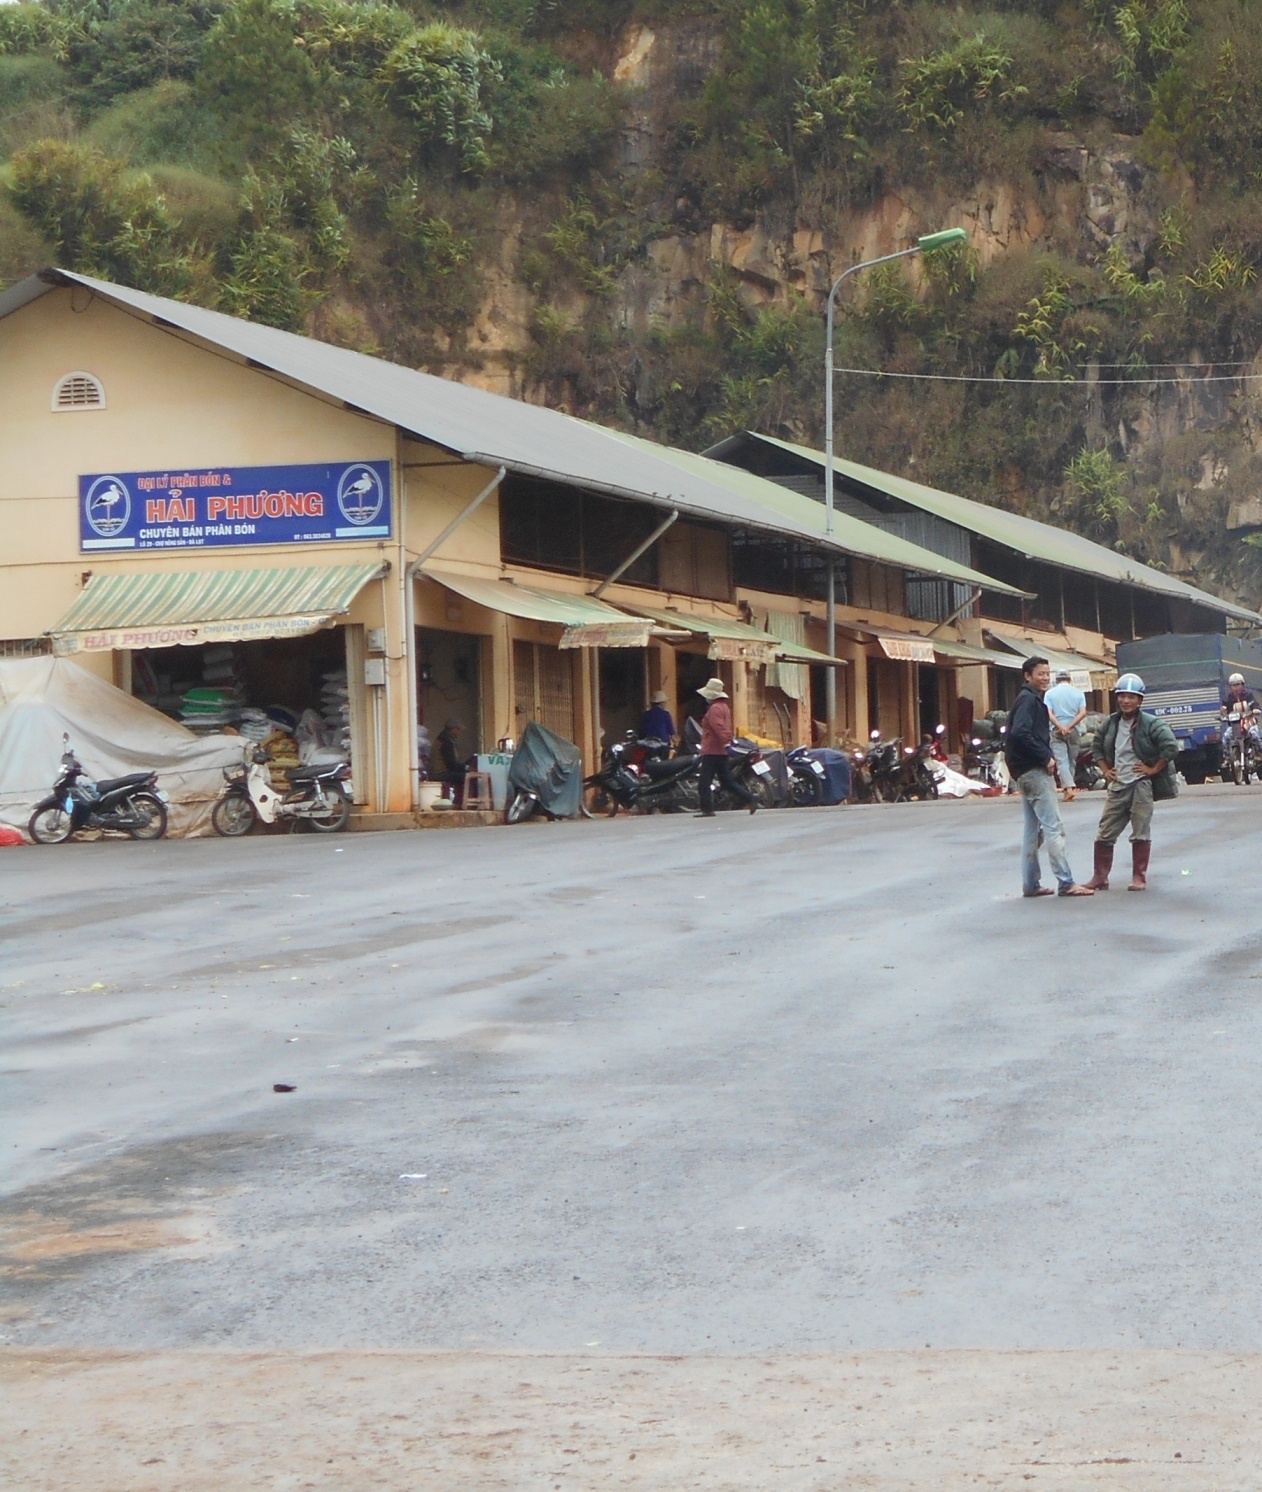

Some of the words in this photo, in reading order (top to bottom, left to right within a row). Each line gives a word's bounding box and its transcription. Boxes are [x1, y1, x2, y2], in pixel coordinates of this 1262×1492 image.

[138, 477, 156, 492] ĐẠI
[156, 474, 169, 489] LÝ
[170, 473, 198, 488] PHÂN
[200, 471, 220, 487] BÓN
[222, 474, 232, 486] &
[146, 489, 196, 523] HẢI
[207, 489, 324, 521] PHƯƠNG
[139, 525, 180, 539] CHUYÊN
[182, 524, 203, 537] BÁN
[205, 523, 232, 536] PHÂN
[234, 522, 256, 535] BÓN
[84, 632, 117, 648] HẢI
